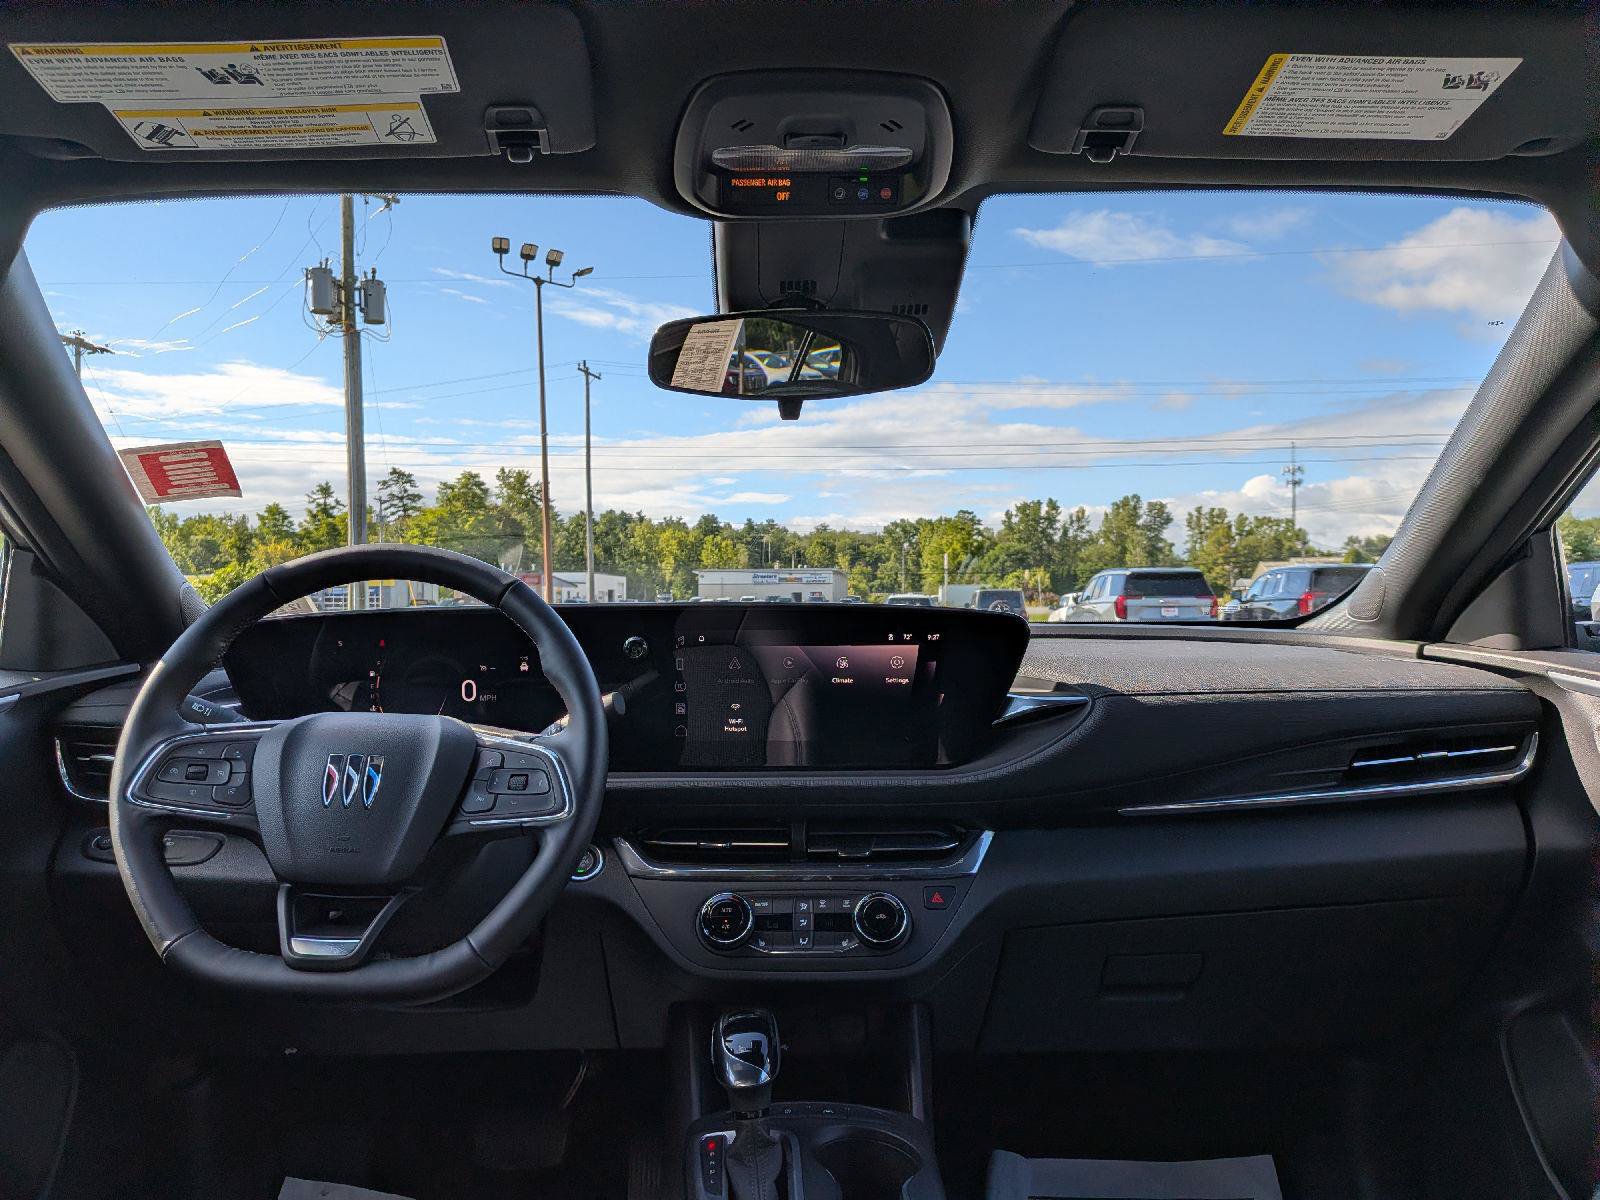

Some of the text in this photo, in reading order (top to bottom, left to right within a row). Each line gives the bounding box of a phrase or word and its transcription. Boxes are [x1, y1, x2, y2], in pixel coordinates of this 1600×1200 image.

[263, 42, 343, 51] AVERTISSEMENT
[34, 47, 84, 55] WARNING
[340, 50, 389, 58] GONFLABLES
[731, 178, 766, 187] PASSENGER
[778, 178, 791, 186] BAG
[776, 192, 790, 200] OFF
[831, 677, 854, 685] Climate
[885, 677, 910, 686] Settings
[461, 679, 477, 702] 0
[479, 694, 497, 702] MPH
[724, 725, 748, 733] Hotspot
